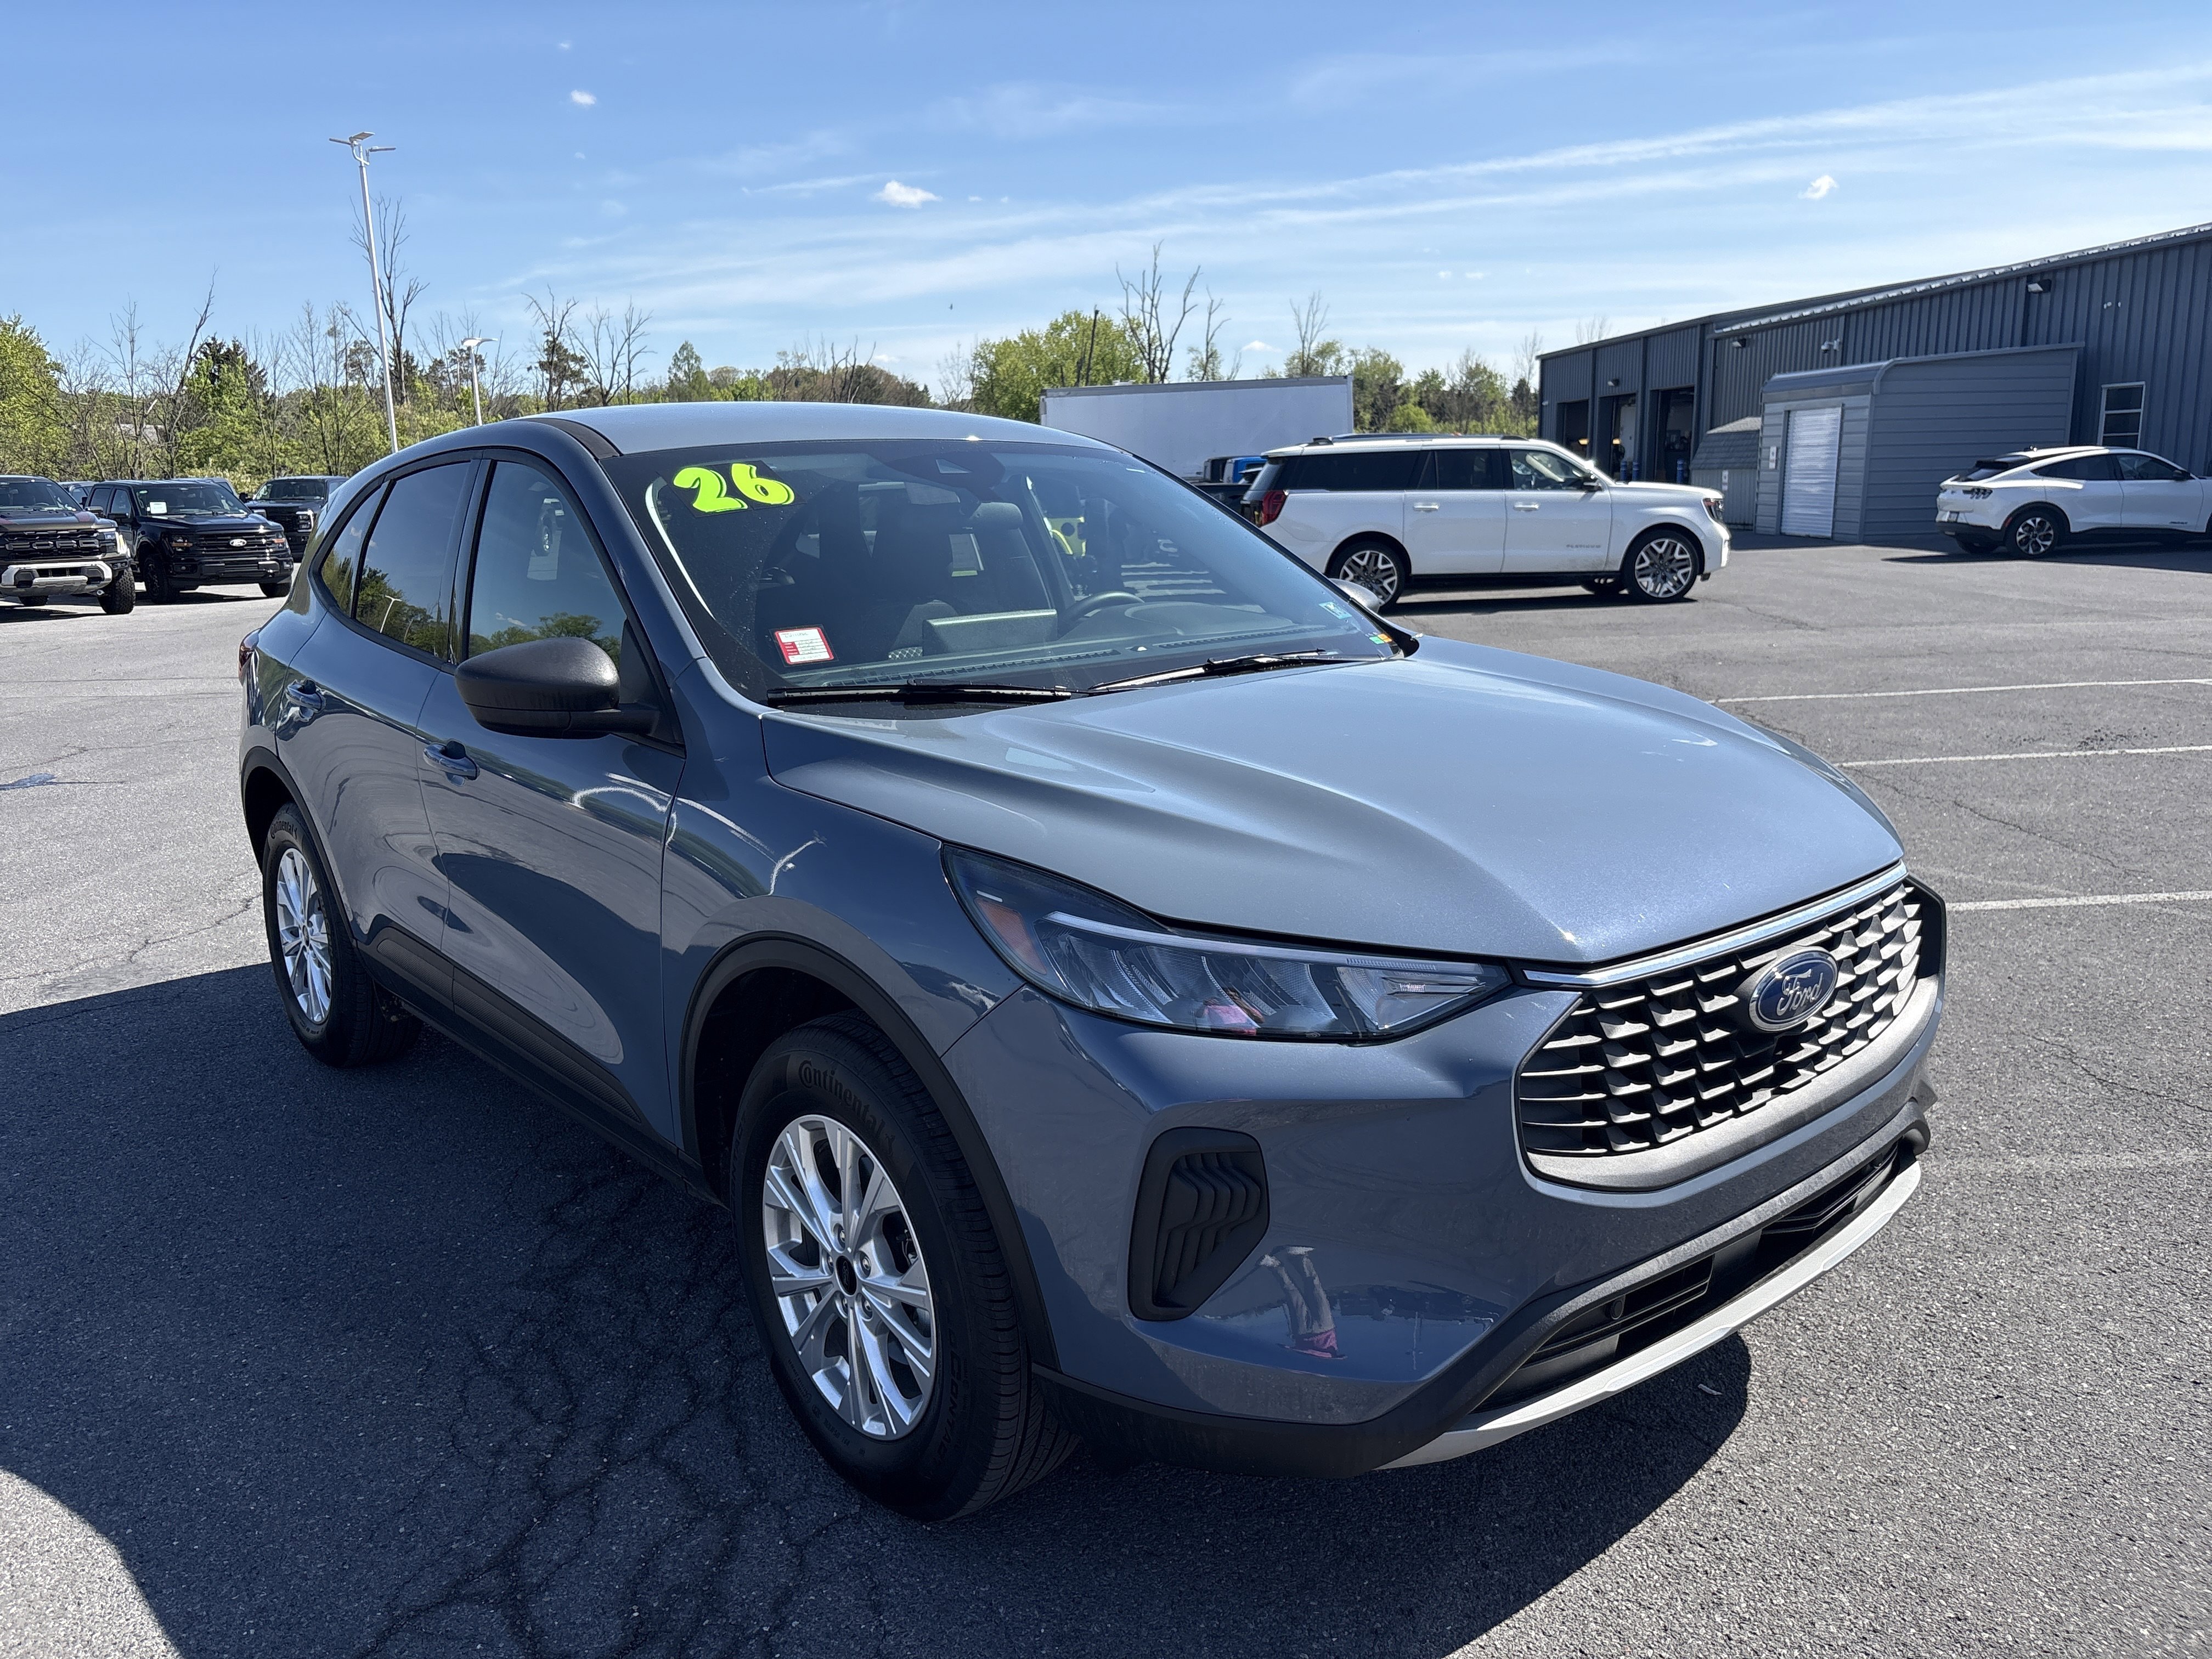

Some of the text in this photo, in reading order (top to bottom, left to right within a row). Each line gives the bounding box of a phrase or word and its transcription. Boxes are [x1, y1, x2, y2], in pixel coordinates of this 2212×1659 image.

[674, 464, 794, 512] 26
[5, 539, 100, 550] FORD
[1776, 969, 1824, 1016] Ford
[799, 1060, 885, 1139] Continental
